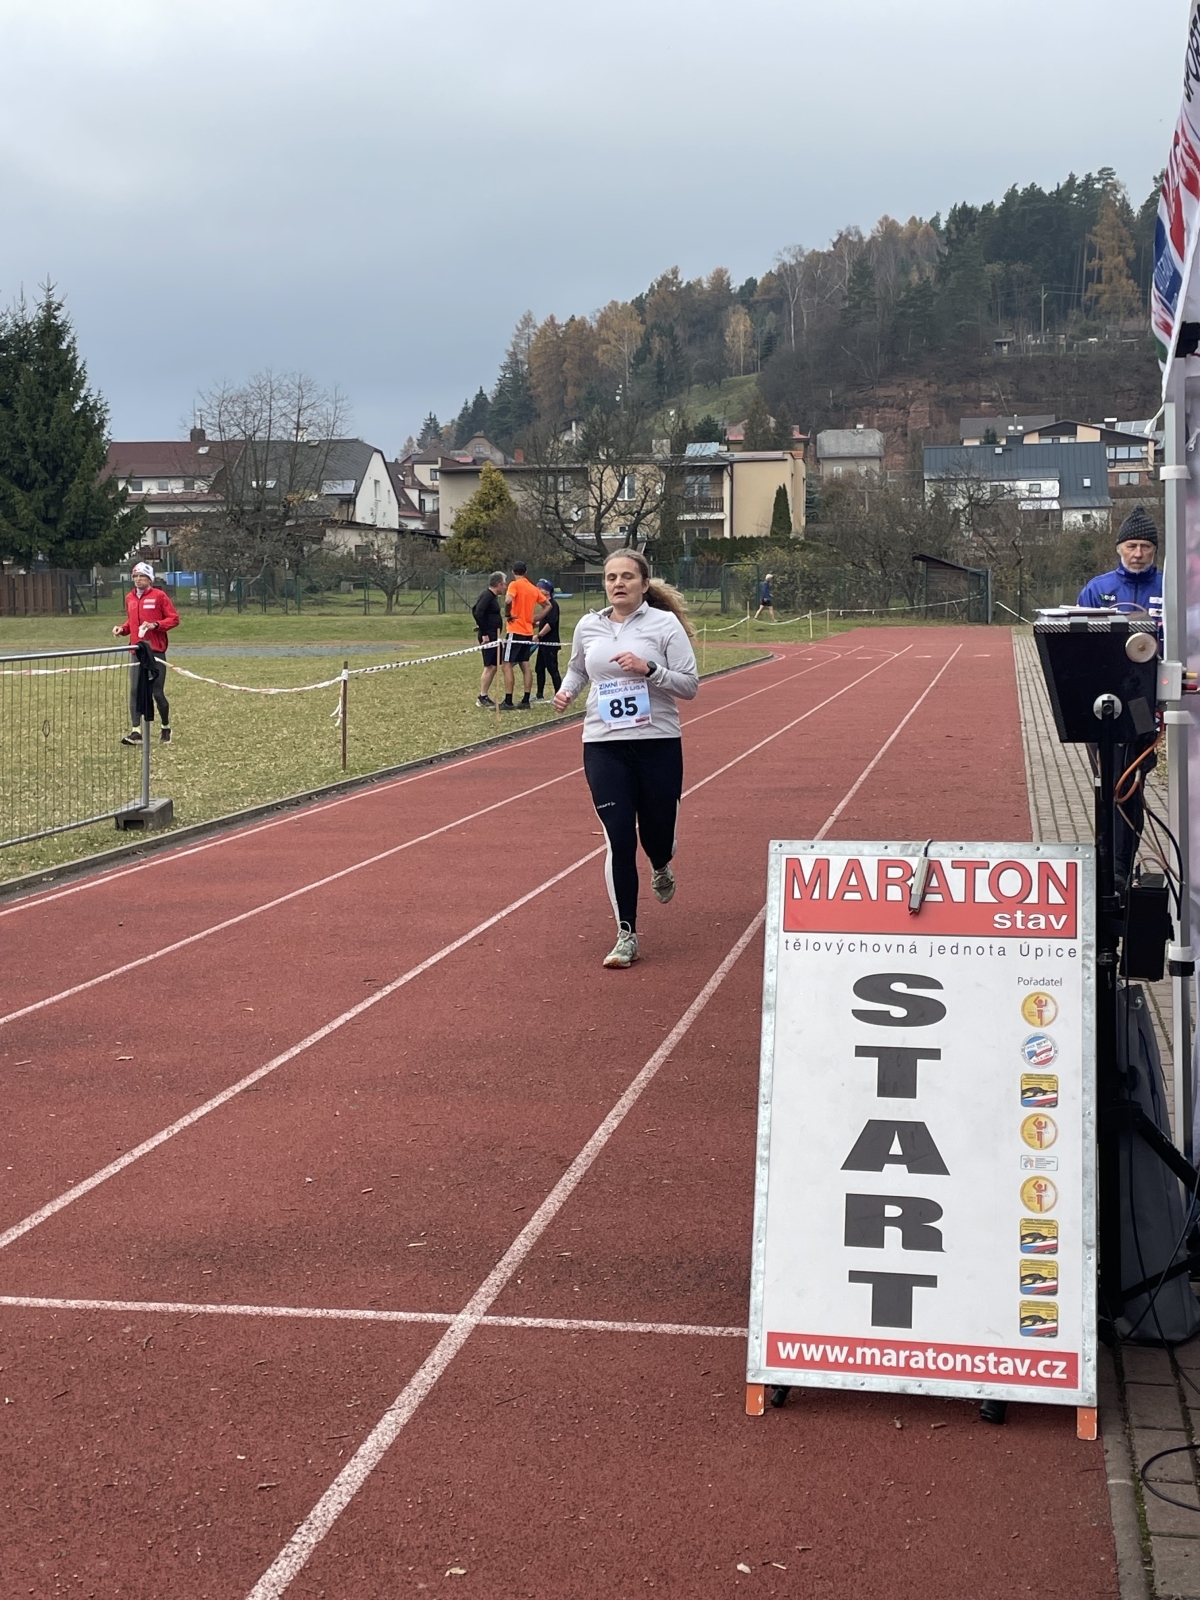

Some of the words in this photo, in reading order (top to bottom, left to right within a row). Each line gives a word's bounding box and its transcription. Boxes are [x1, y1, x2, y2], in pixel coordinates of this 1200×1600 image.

[610, 696, 638, 718] 85
[784, 857, 1078, 905] MARATON
[993, 910, 1069, 931] stav
[784, 938, 918, 956] tělovýchovná
[929, 942, 1007, 958] jednota
[1019, 943, 1078, 960] Úpice
[1017, 976, 1063, 987] Pořadatel
[840, 973, 951, 1330] START
[777, 1340, 1068, 1381] www.maratonstav.cz
